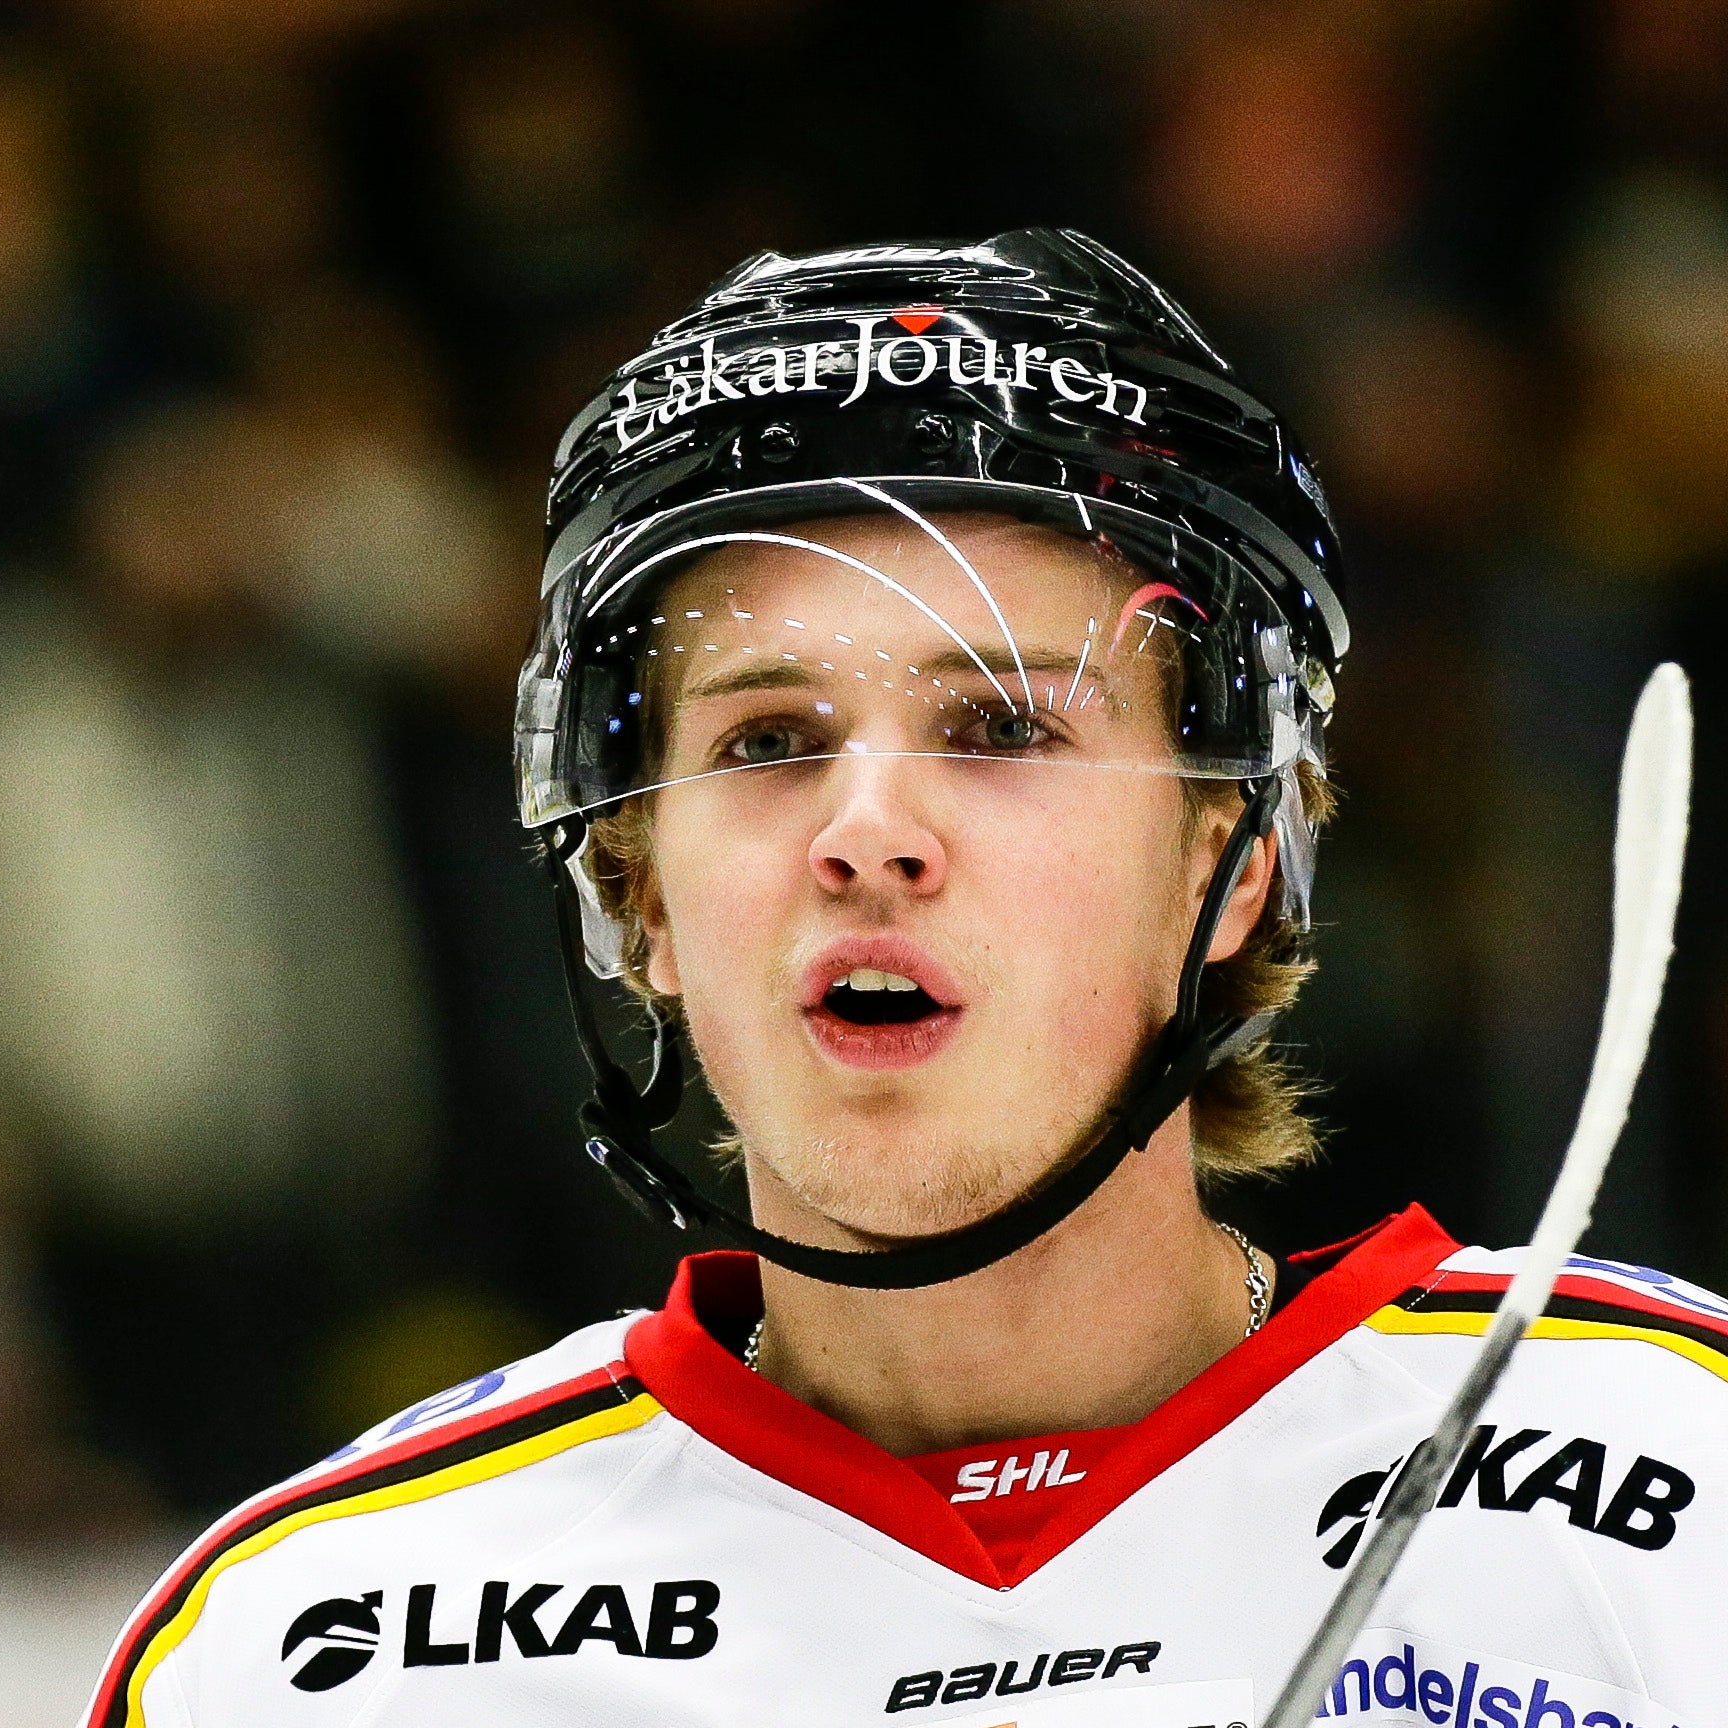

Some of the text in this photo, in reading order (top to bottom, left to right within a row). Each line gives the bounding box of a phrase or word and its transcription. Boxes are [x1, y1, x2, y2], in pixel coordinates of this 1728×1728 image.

[950, 1449, 1088, 1504] SHL
[1376, 1425, 1696, 1551] KAB
[403, 1579, 720, 1669] LKAB
